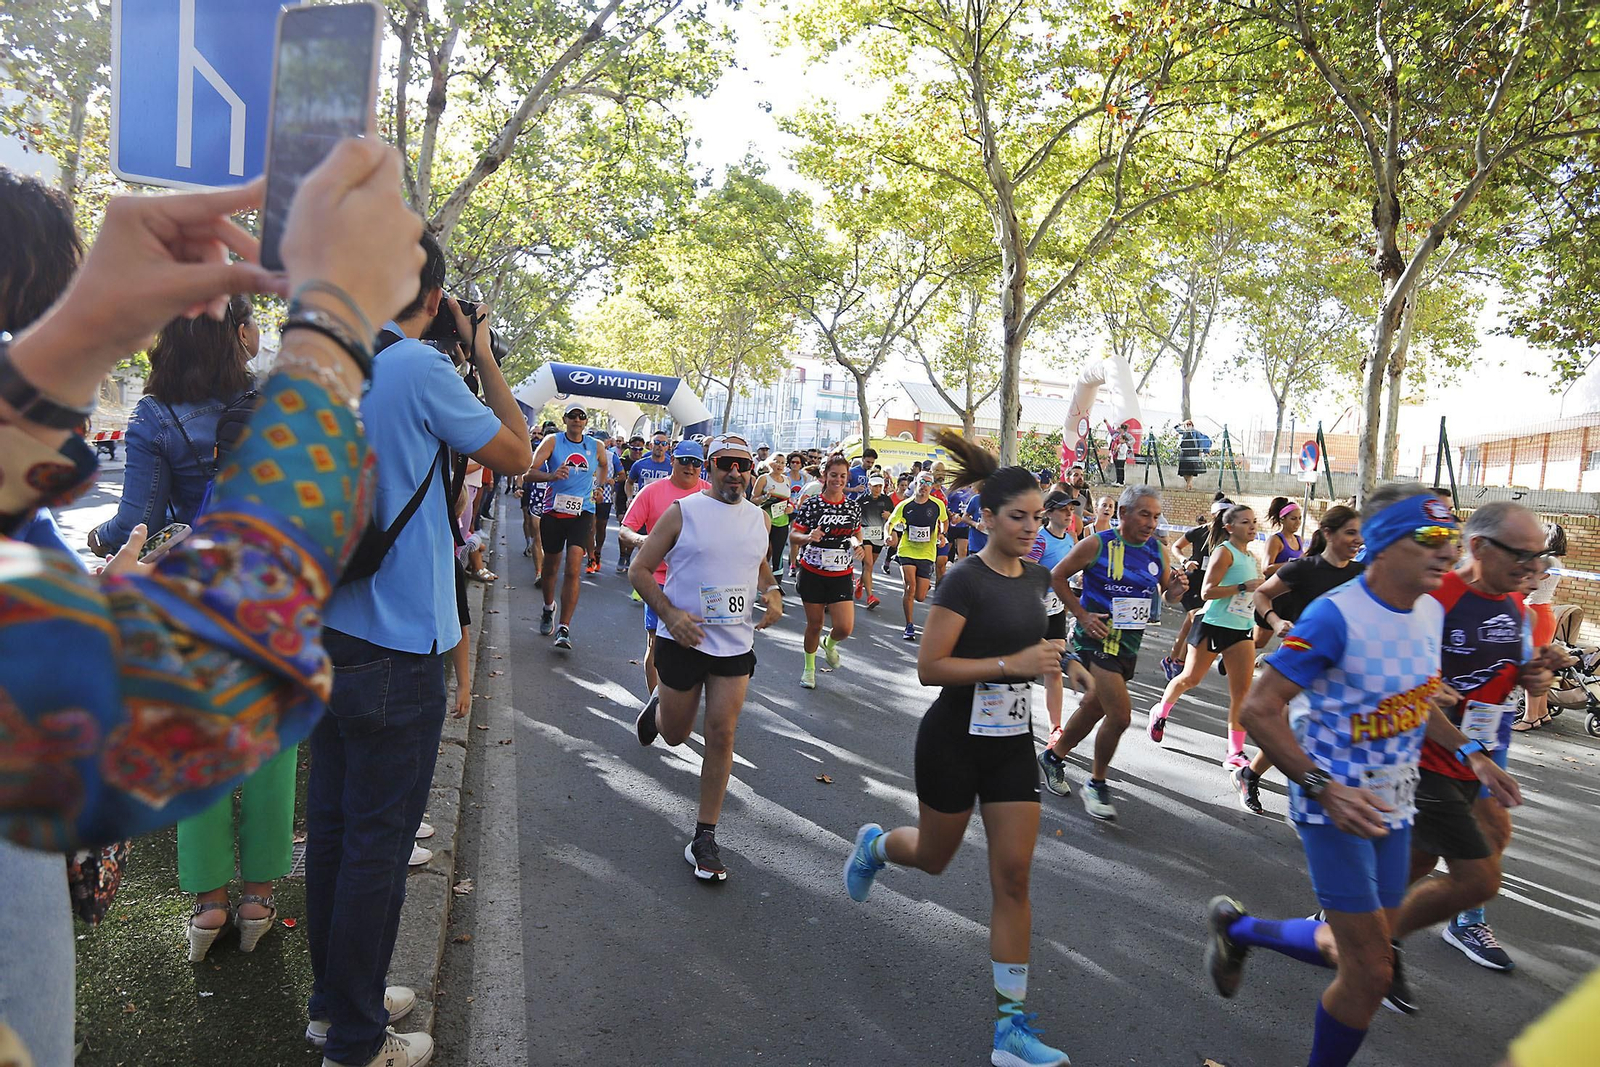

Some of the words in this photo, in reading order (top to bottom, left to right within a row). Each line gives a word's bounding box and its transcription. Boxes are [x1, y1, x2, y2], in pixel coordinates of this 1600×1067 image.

[598, 375, 661, 392] HYUNDAI
[626, 391, 660, 402] SYRLUZ
[565, 500, 581, 511] 553
[818, 514, 851, 525] CORRE
[917, 530, 929, 538] 281
[834, 555, 848, 565] 413
[728, 596, 745, 613] 89
[1132, 606, 1149, 620] 364
[1008, 697, 1026, 720] 43
